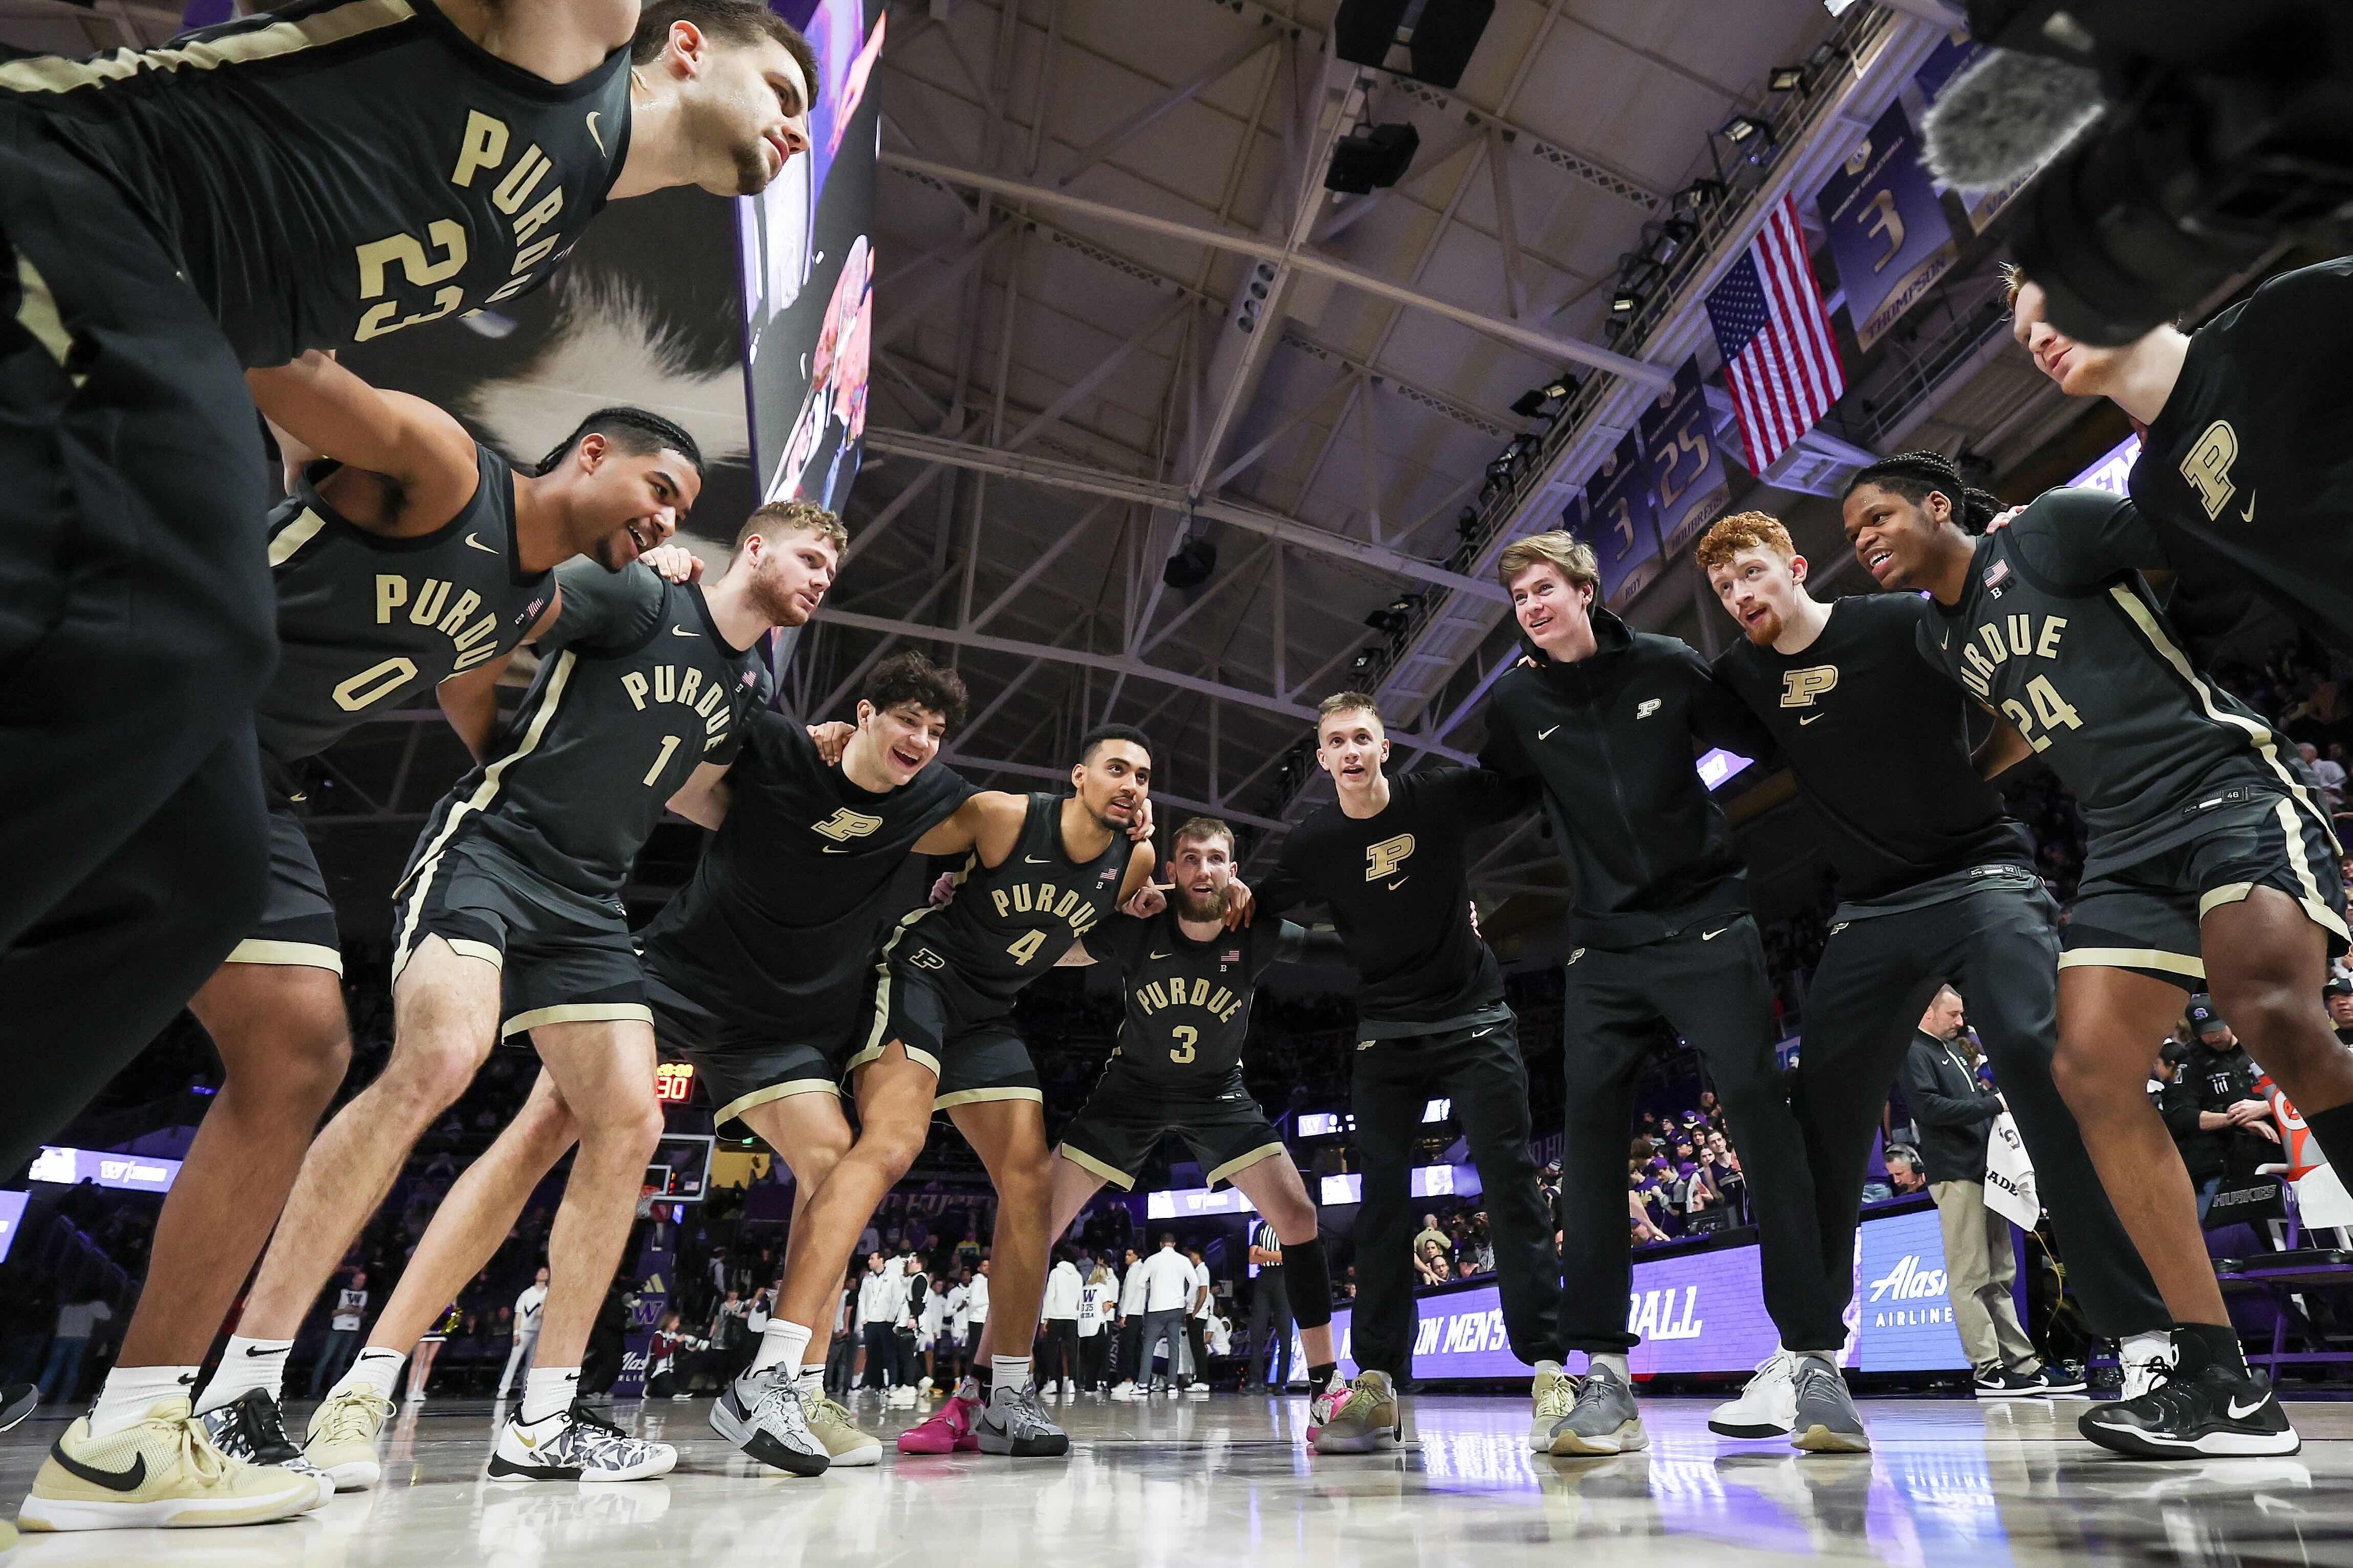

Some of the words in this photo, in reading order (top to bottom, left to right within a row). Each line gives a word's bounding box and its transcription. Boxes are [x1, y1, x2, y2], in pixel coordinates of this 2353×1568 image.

[451, 109, 563, 318] PURDU
[1857, 189, 1905, 273] 3
[1655, 410, 1709, 509] 25
[2179, 419, 2239, 521] P
[1608, 496, 1634, 561] 3
[376, 574, 498, 684] PURDU
[332, 657, 418, 711] 0
[1960, 614, 2068, 709] URDUE
[1637, 698, 1661, 720] P
[1780, 664, 1839, 708] P
[2001, 674, 2084, 753] 24
[643, 735, 681, 787] 1
[812, 807, 883, 842] P
[1366, 833, 1415, 882] P
[909, 947, 945, 969] P
[1006, 929, 1047, 966] 4
[1136, 977, 1243, 1023] PURDUE
[1170, 1025, 1198, 1064] 3
[656, 1077, 687, 1099] 30
[2212, 1184, 2277, 1207] HUSKIES
[1083, 1289, 1097, 1303] W
[1869, 1255, 1947, 1303] Alas
[632, 1300, 664, 1325] W
[1441, 1308, 1506, 1354] MEN'S
[1875, 1307, 1954, 1328] AIRLINE
